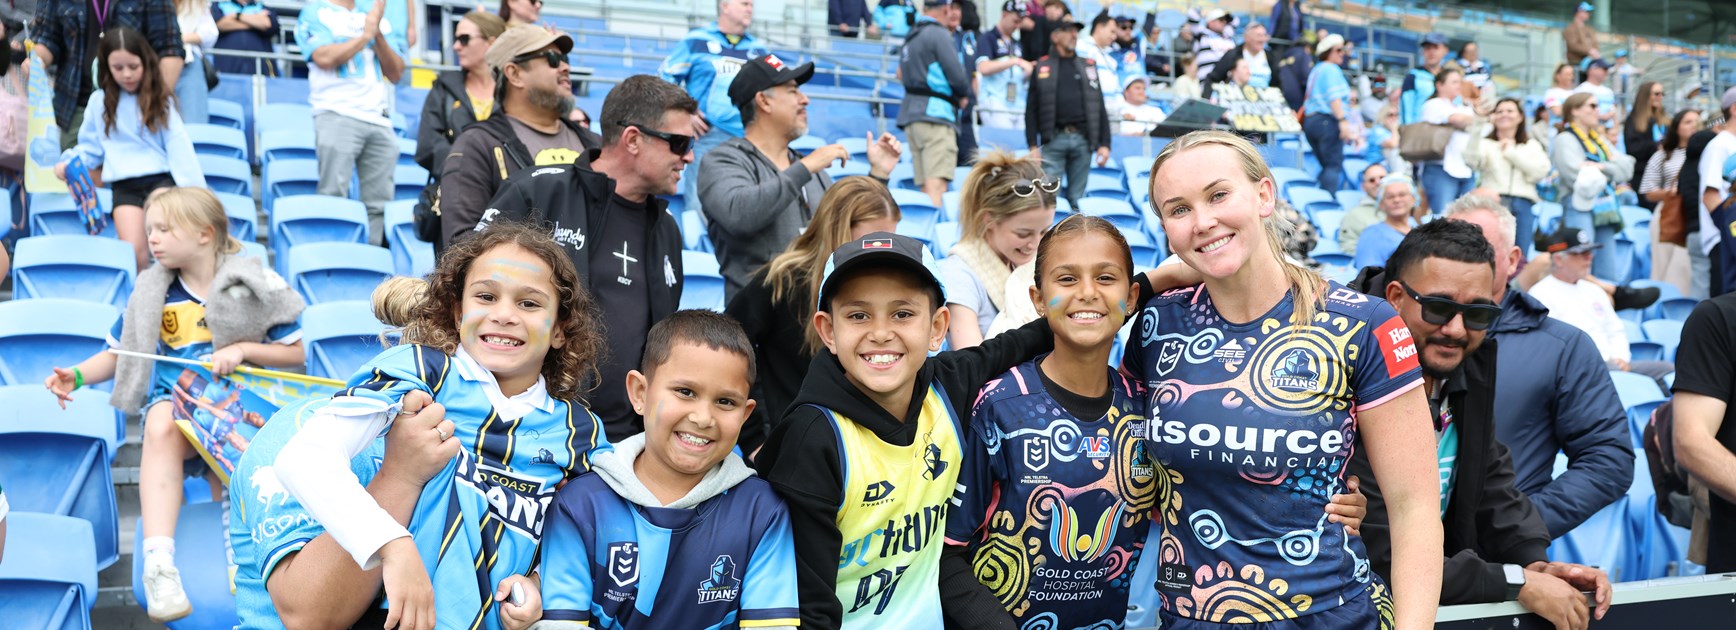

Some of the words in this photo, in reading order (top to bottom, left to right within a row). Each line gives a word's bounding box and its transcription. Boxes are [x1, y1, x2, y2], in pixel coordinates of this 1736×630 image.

[1212, 349, 1247, 359] SEE
[1272, 377, 1318, 390] TITANS
[1077, 436, 1110, 453] AVS
[1191, 449, 1339, 468] FINANCIAL
[1131, 466, 1153, 477] TITANS
[491, 474, 536, 494] COAST
[860, 497, 895, 508] DYNASTY
[1036, 567, 1070, 579] GOLD
[1074, 567, 1109, 580] COAST
[1043, 580, 1096, 591] HOSPITAL
[699, 589, 738, 602] TITANS
[1027, 590, 1103, 601] FOUNDATION
